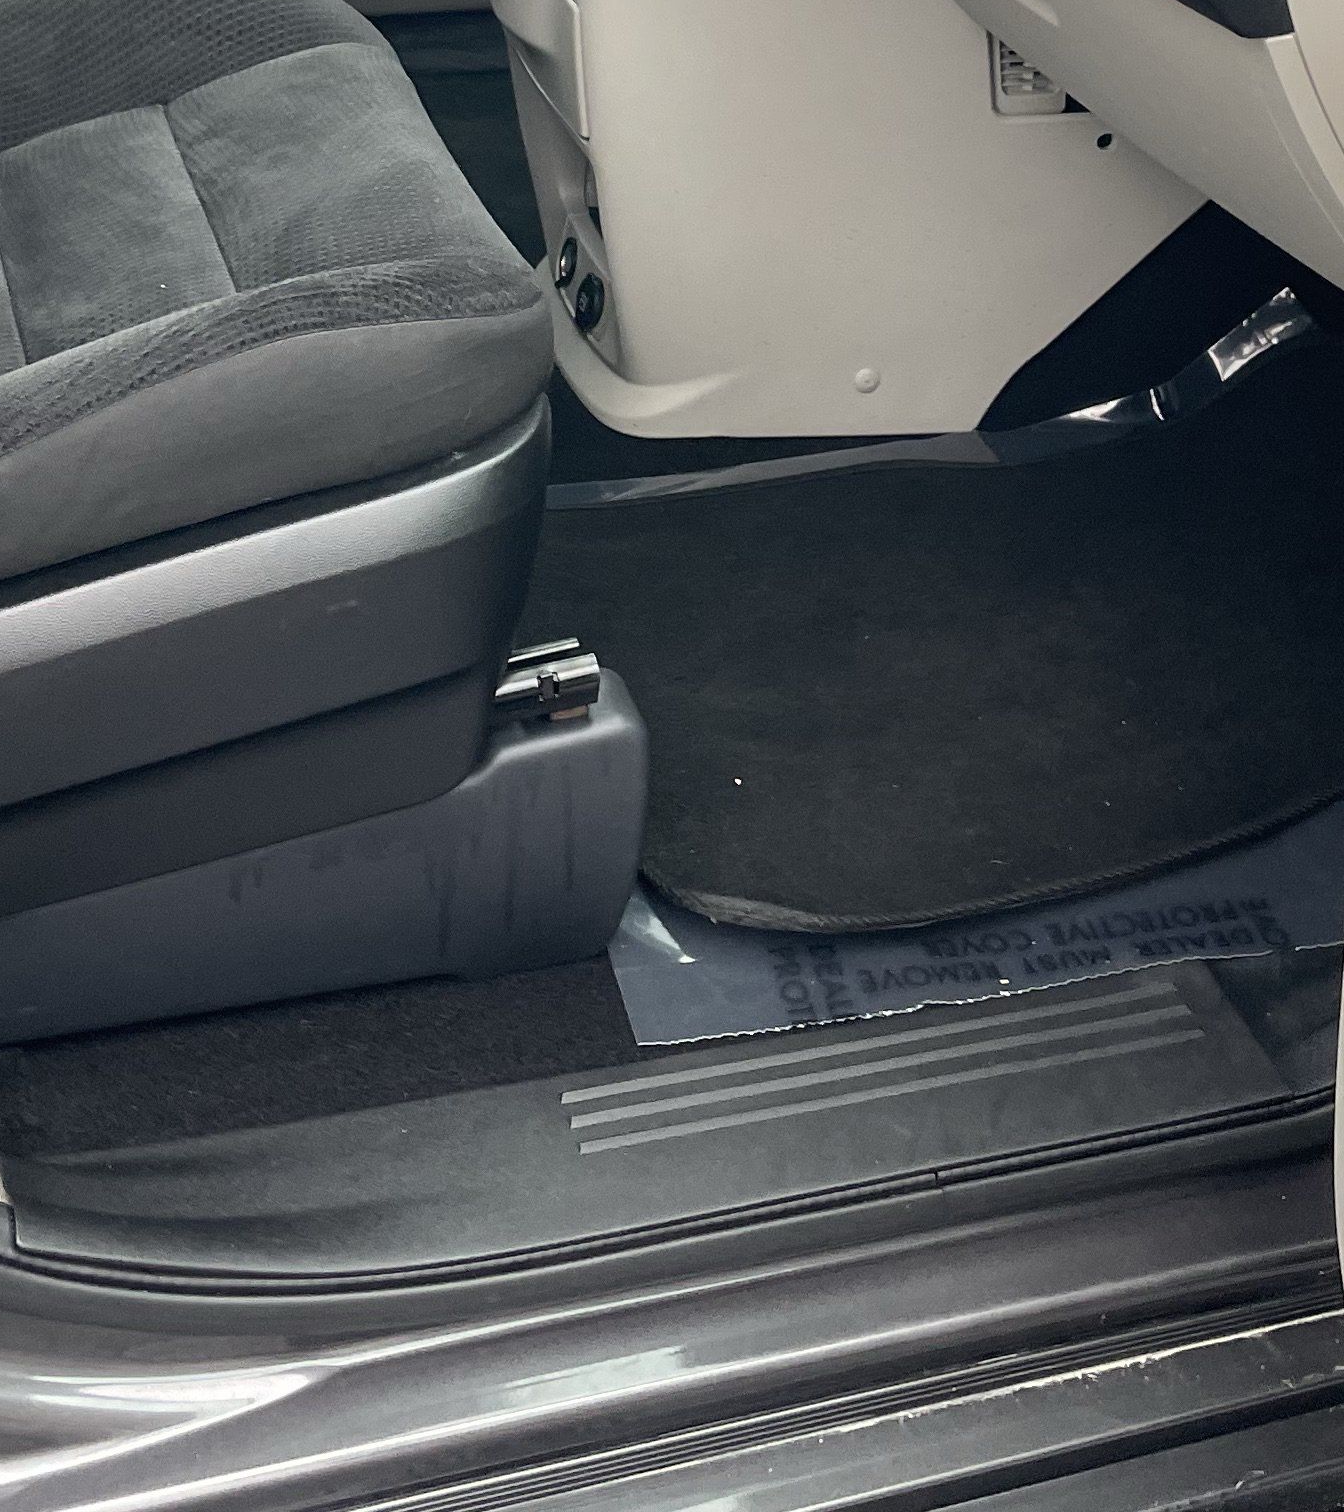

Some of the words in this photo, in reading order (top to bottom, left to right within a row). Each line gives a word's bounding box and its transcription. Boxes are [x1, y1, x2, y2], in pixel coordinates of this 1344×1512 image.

[1047, 899, 1239, 947] PROTECTIVE
[1134, 926, 1254, 956] DEALER
[1022, 946, 1111, 974] MUST
[858, 960, 1001, 992] REMOVE
